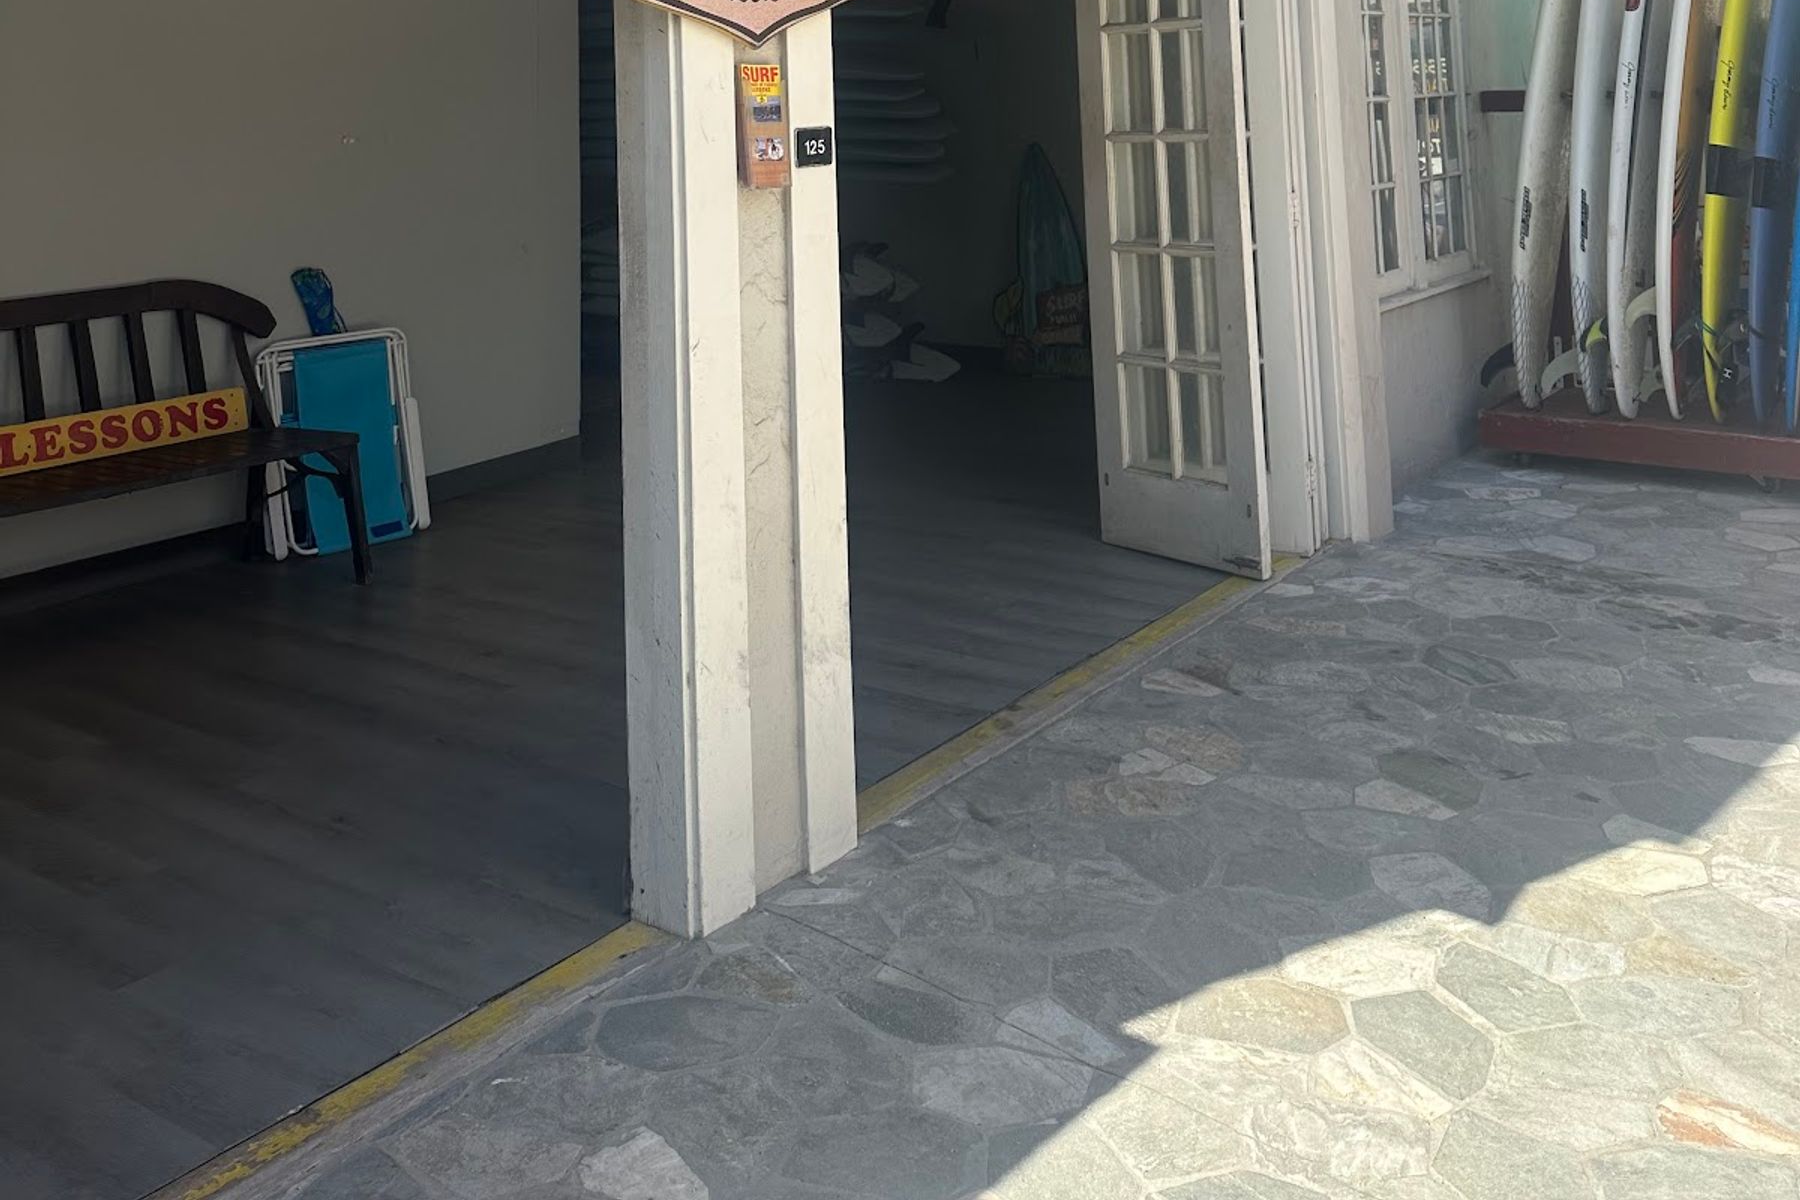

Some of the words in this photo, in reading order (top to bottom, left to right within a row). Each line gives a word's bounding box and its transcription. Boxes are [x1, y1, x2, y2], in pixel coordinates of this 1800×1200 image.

[742, 66, 778, 82] SURF
[804, 139, 825, 155] 125
[0, 397, 229, 467] LESSONS
